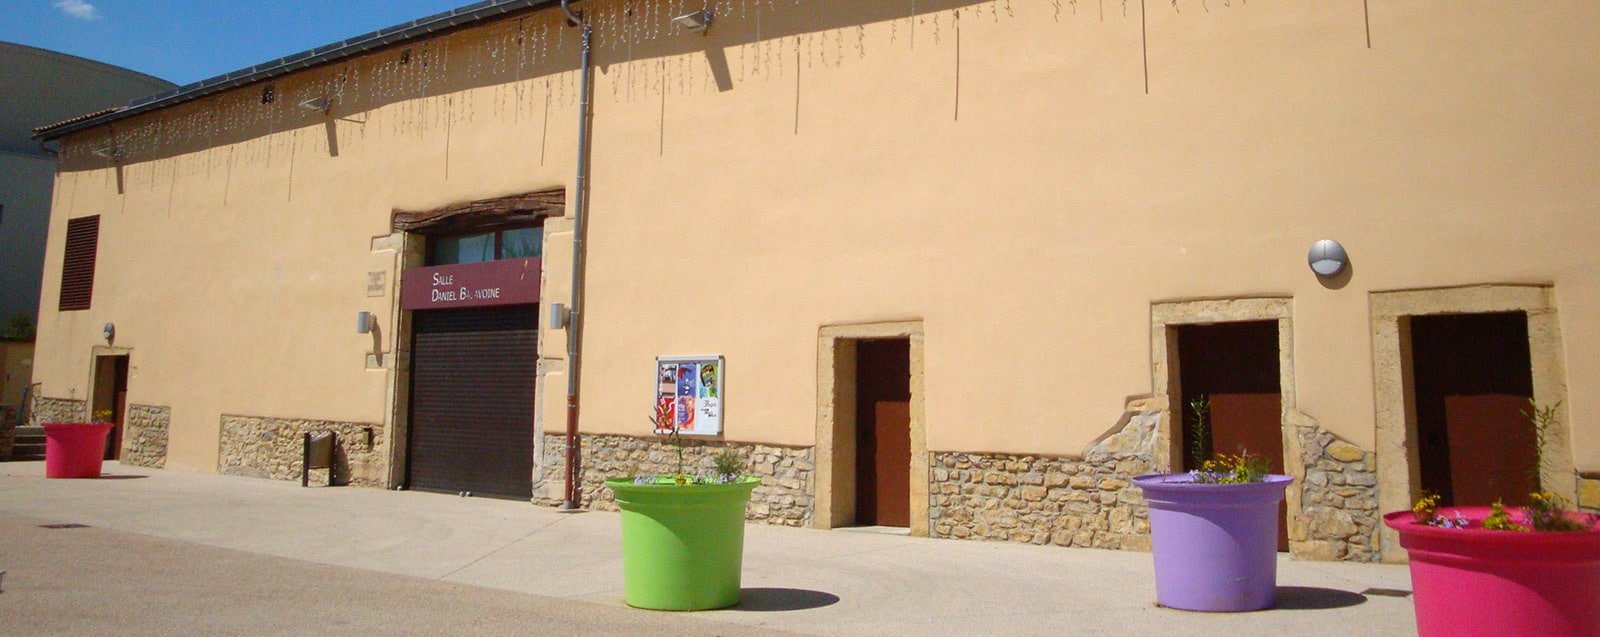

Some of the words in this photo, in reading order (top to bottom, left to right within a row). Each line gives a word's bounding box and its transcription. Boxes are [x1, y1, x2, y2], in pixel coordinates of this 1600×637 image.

[432, 272, 454, 286] SALLE
[431, 288, 457, 302] DANIEL
[459, 286, 500, 301] BAAVOINE
